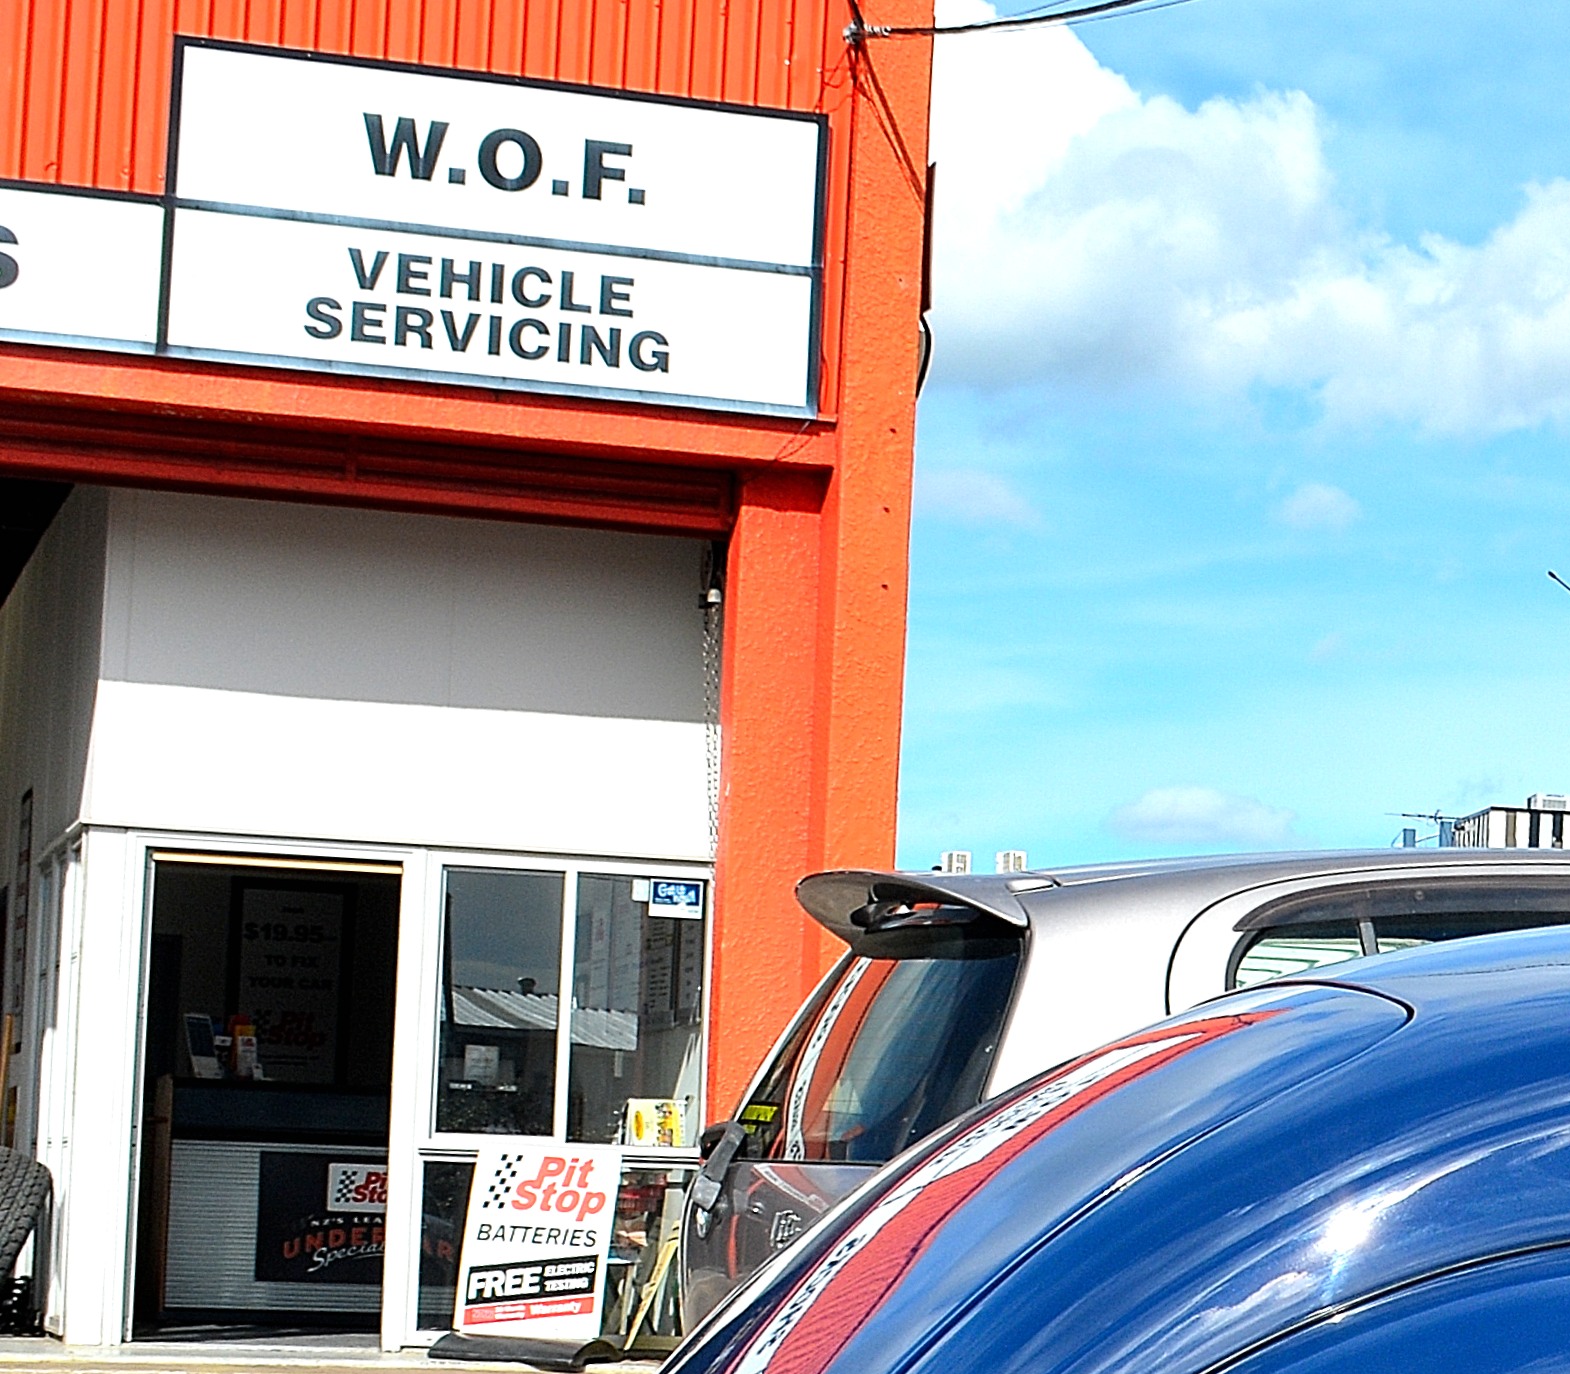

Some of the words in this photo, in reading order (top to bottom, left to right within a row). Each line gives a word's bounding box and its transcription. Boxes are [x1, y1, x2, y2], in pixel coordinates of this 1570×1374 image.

[363, 112, 646, 206] W.O.F.
[348, 247, 635, 318] VEHICLE
[303, 297, 671, 374] SERVICING
[264, 953, 287, 968] TO
[248, 975, 294, 990] YOUR
[364, 1171, 388, 1188] Pi
[533, 1156, 594, 1189] Pit
[352, 1184, 387, 1203] Sto
[511, 1179, 607, 1222] Stop
[476, 1223, 598, 1248] BATTERIES
[467, 1265, 543, 1300] FREE
[543, 1261, 596, 1278] ELECTRIC
